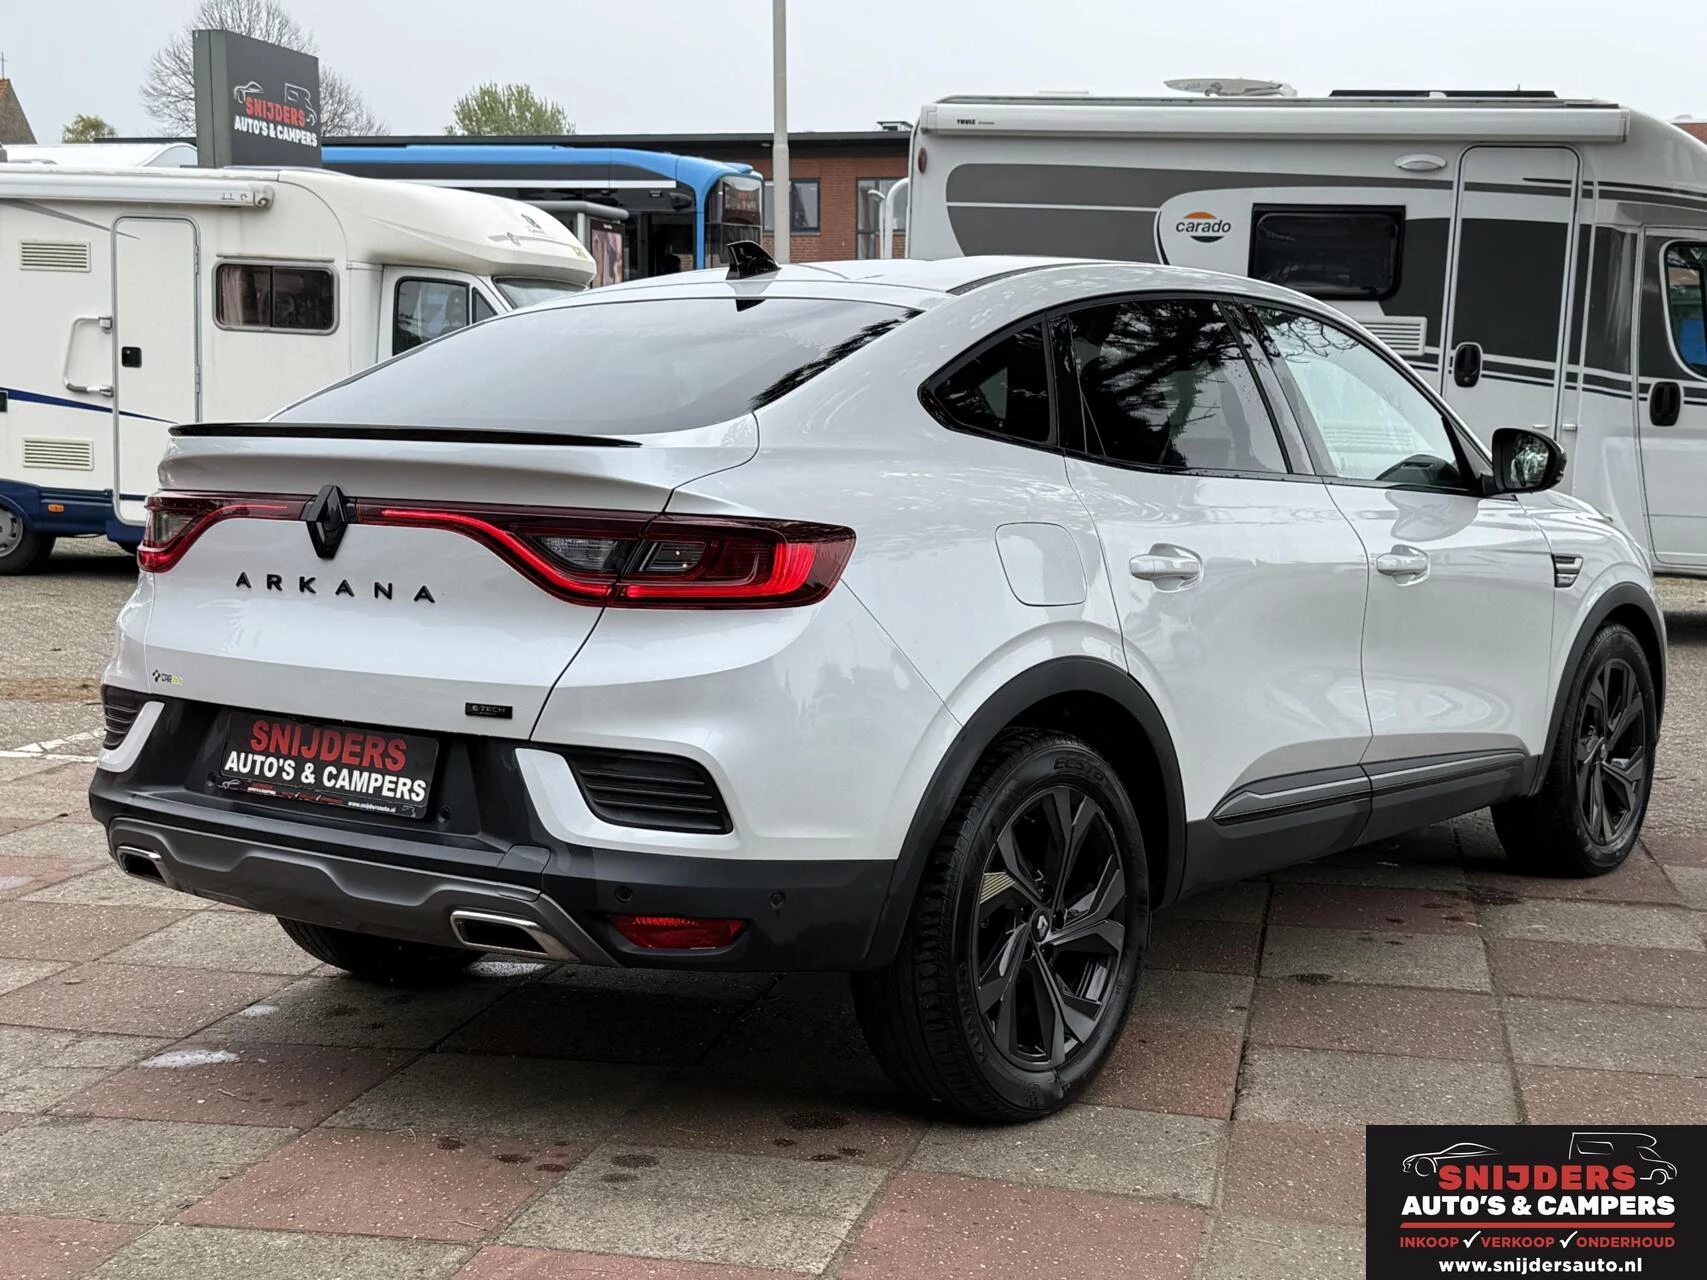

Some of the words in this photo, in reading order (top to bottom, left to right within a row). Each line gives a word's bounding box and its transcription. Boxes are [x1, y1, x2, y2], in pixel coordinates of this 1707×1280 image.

[245, 96, 306, 128] SNIJDERS
[234, 115, 269, 136] AUTO'S
[269, 123, 277, 139] &
[276, 125, 318, 147] CAMPERS
[1175, 219, 1232, 234] carado
[235, 571, 436, 604] ARKANA
[250, 719, 408, 772] SNIJDERS
[224, 751, 295, 781] AUTO'S
[300, 763, 316, 785] &
[322, 765, 427, 802] CAMPERS
